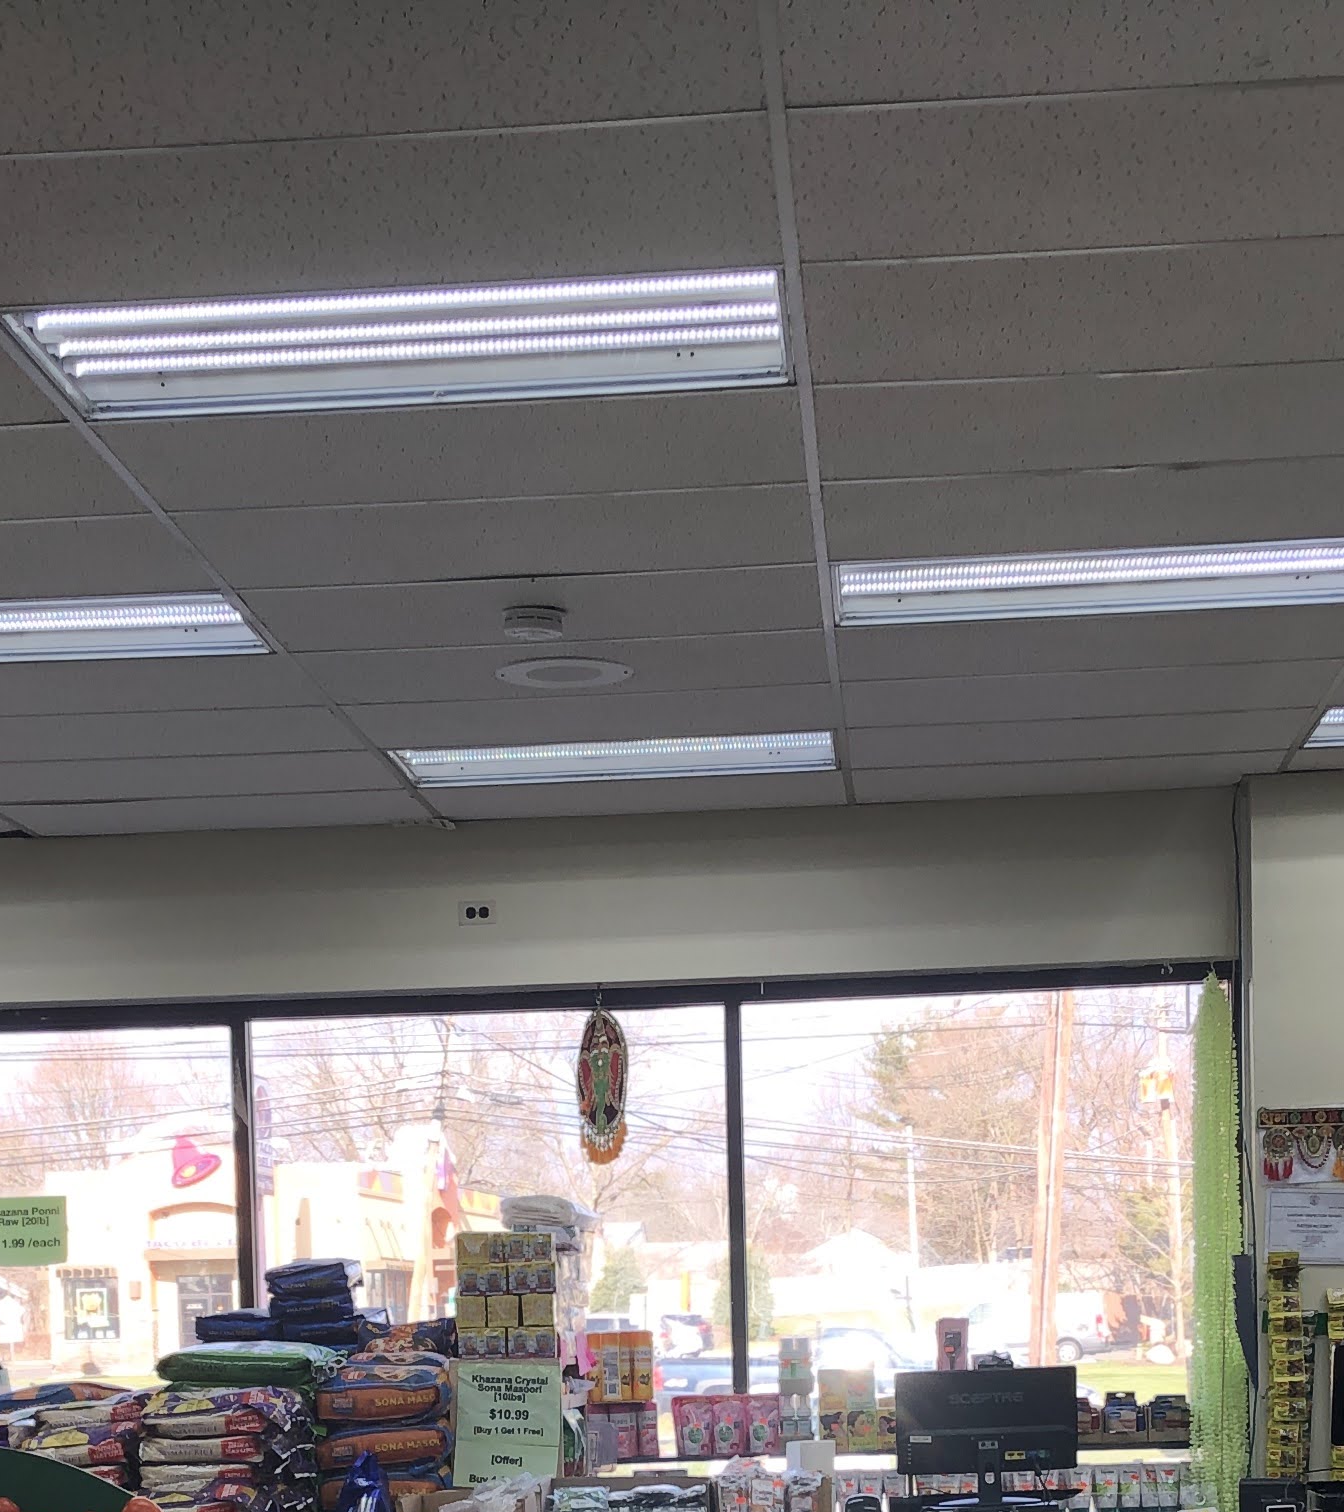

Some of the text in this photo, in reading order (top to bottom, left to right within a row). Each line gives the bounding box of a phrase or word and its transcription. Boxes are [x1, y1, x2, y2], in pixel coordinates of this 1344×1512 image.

[31, 1206, 60, 1216] Ponni
[21, 1216, 50, 1227] [20lb]
[27, 1236, 61, 1249] /each
[471, 1374, 549, 1386] Khazana Crystal
[477, 1384, 543, 1394] Sona Masoori
[374, 1396, 405, 1408] SONA
[493, 1392, 526, 1403] [10lbs]
[488, 1408, 529, 1421] $10.99
[473, 1426, 492, 1436] [Buy
[500, 1427, 515, 1435] Get
[522, 1427, 544, 1436] Free]
[374, 1441, 406, 1453] SONA
[490, 1454, 523, 1467] [Offer]
